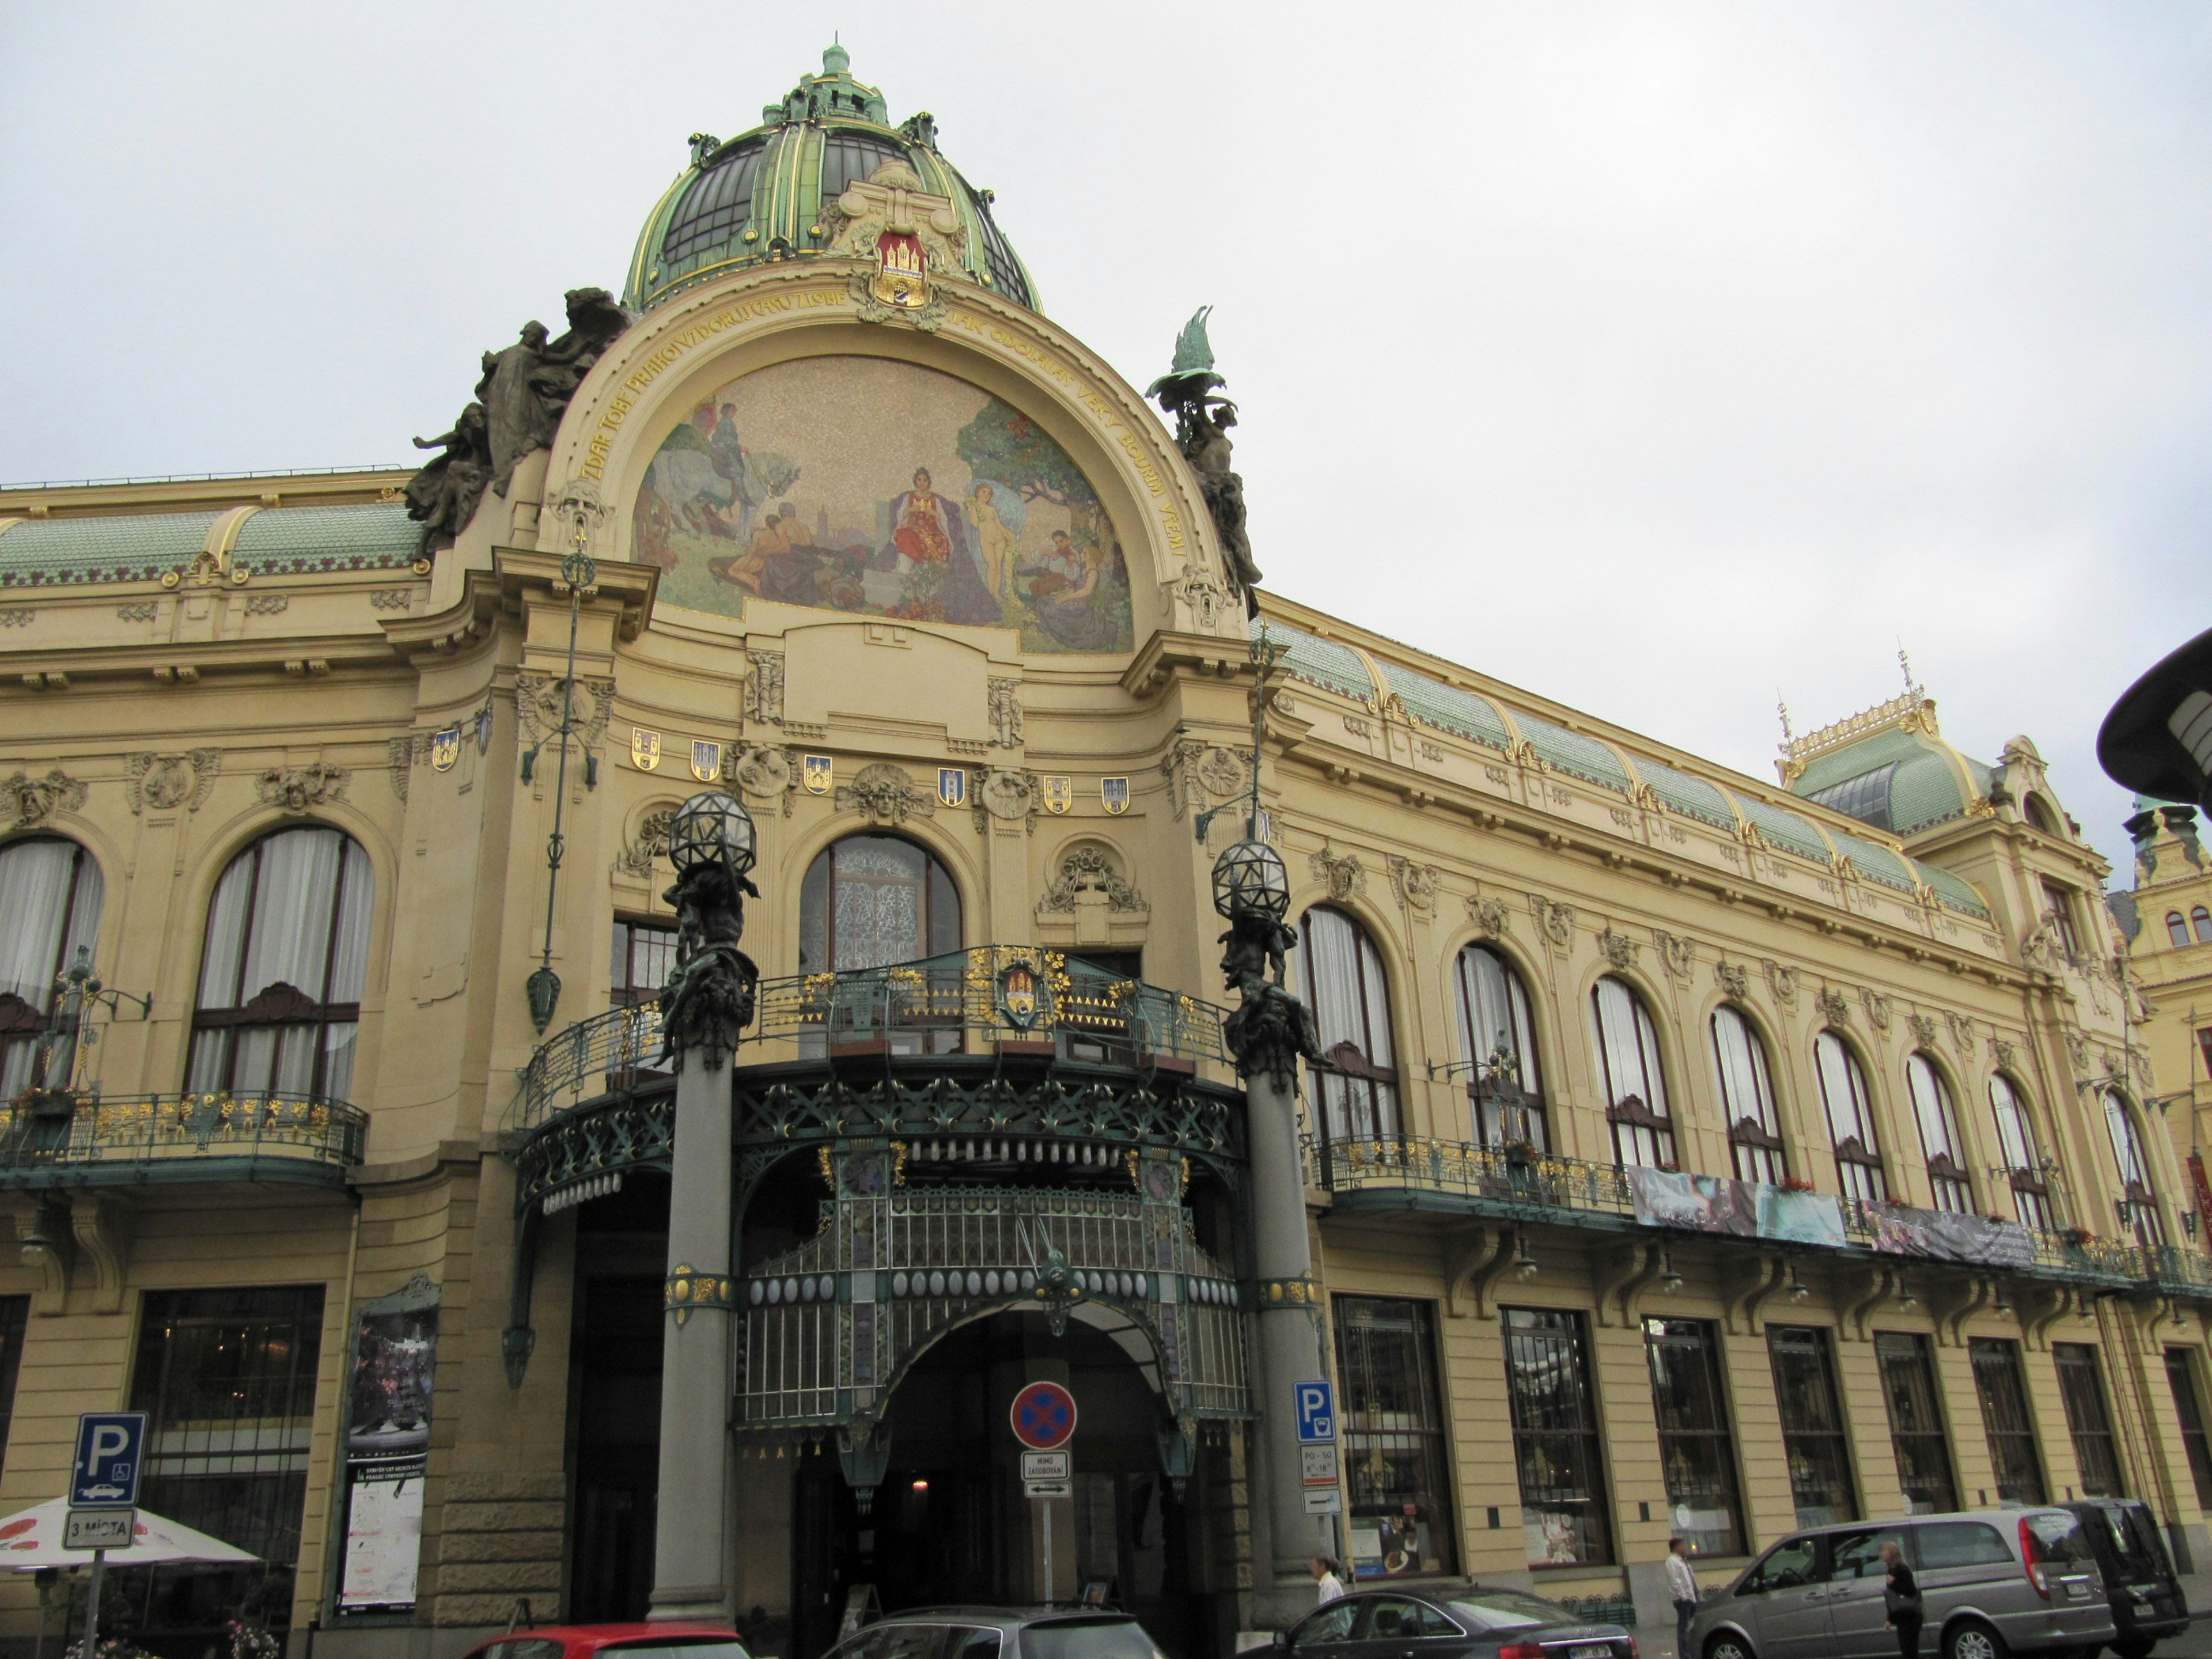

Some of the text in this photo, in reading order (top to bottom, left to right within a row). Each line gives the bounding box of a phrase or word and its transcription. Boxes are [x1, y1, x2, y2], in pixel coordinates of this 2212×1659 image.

[947, 312, 987, 335] JAK
[579, 434, 613, 480] ZDAR
[674, 304, 753, 349] VZDORUJ
[1302, 1389, 1324, 1423] P
[88, 1425, 129, 1476] P
[1037, 1457, 1053, 1465] MIMO
[72, 1523, 79, 1537] 3
